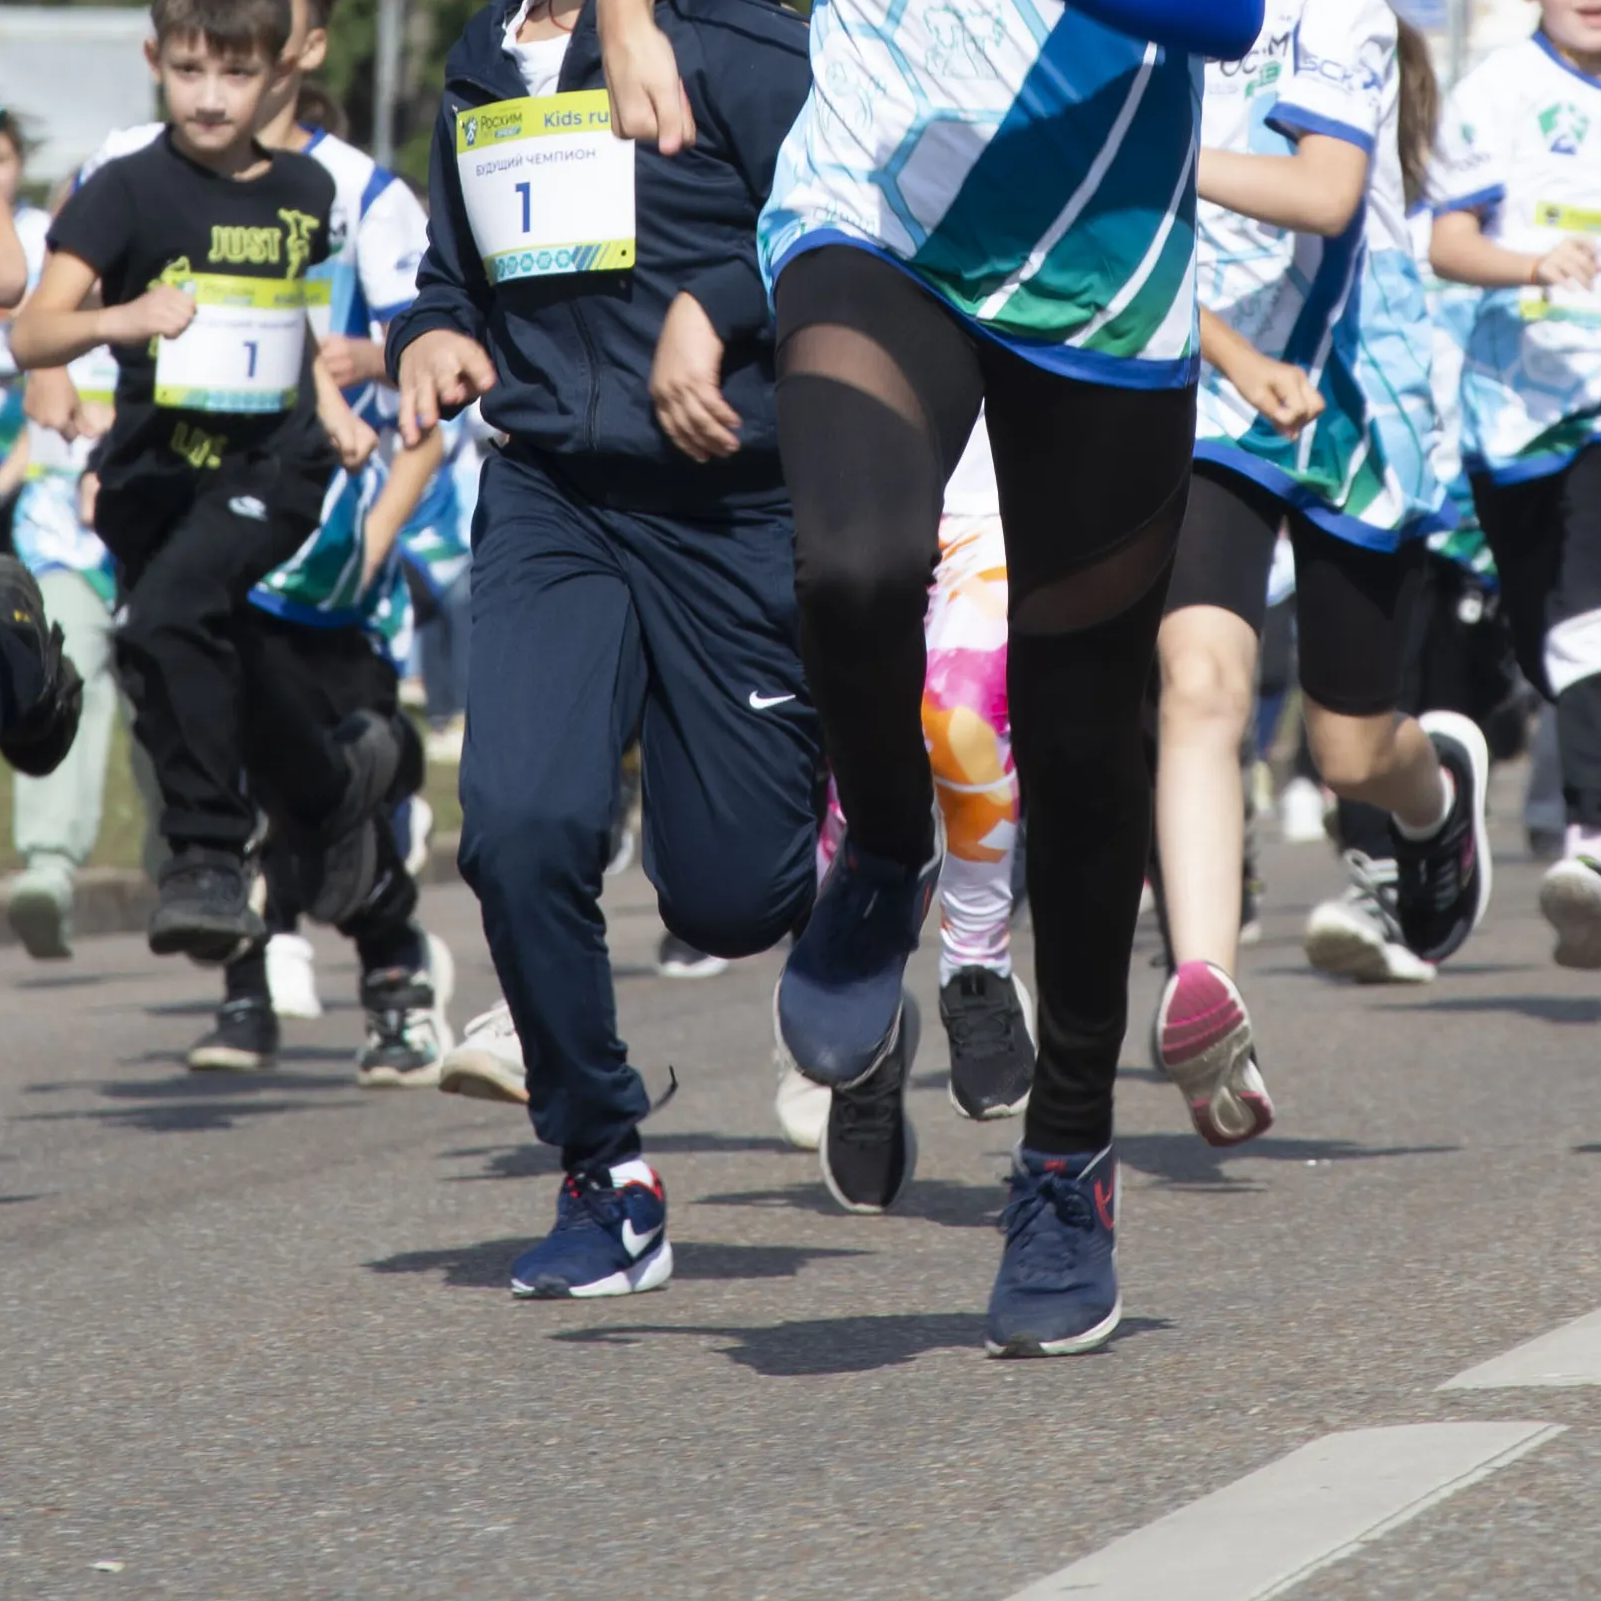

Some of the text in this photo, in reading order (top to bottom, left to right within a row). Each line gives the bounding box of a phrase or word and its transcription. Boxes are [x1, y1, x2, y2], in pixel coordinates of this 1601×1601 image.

[543, 109, 610, 127] Kids ru
[475, 148, 596, 177] БУДУЩИЙ ЧЕМПИОН
[515, 181, 531, 233] 1
[208, 225, 281, 264] JUST
[243, 340, 259, 378] 1
